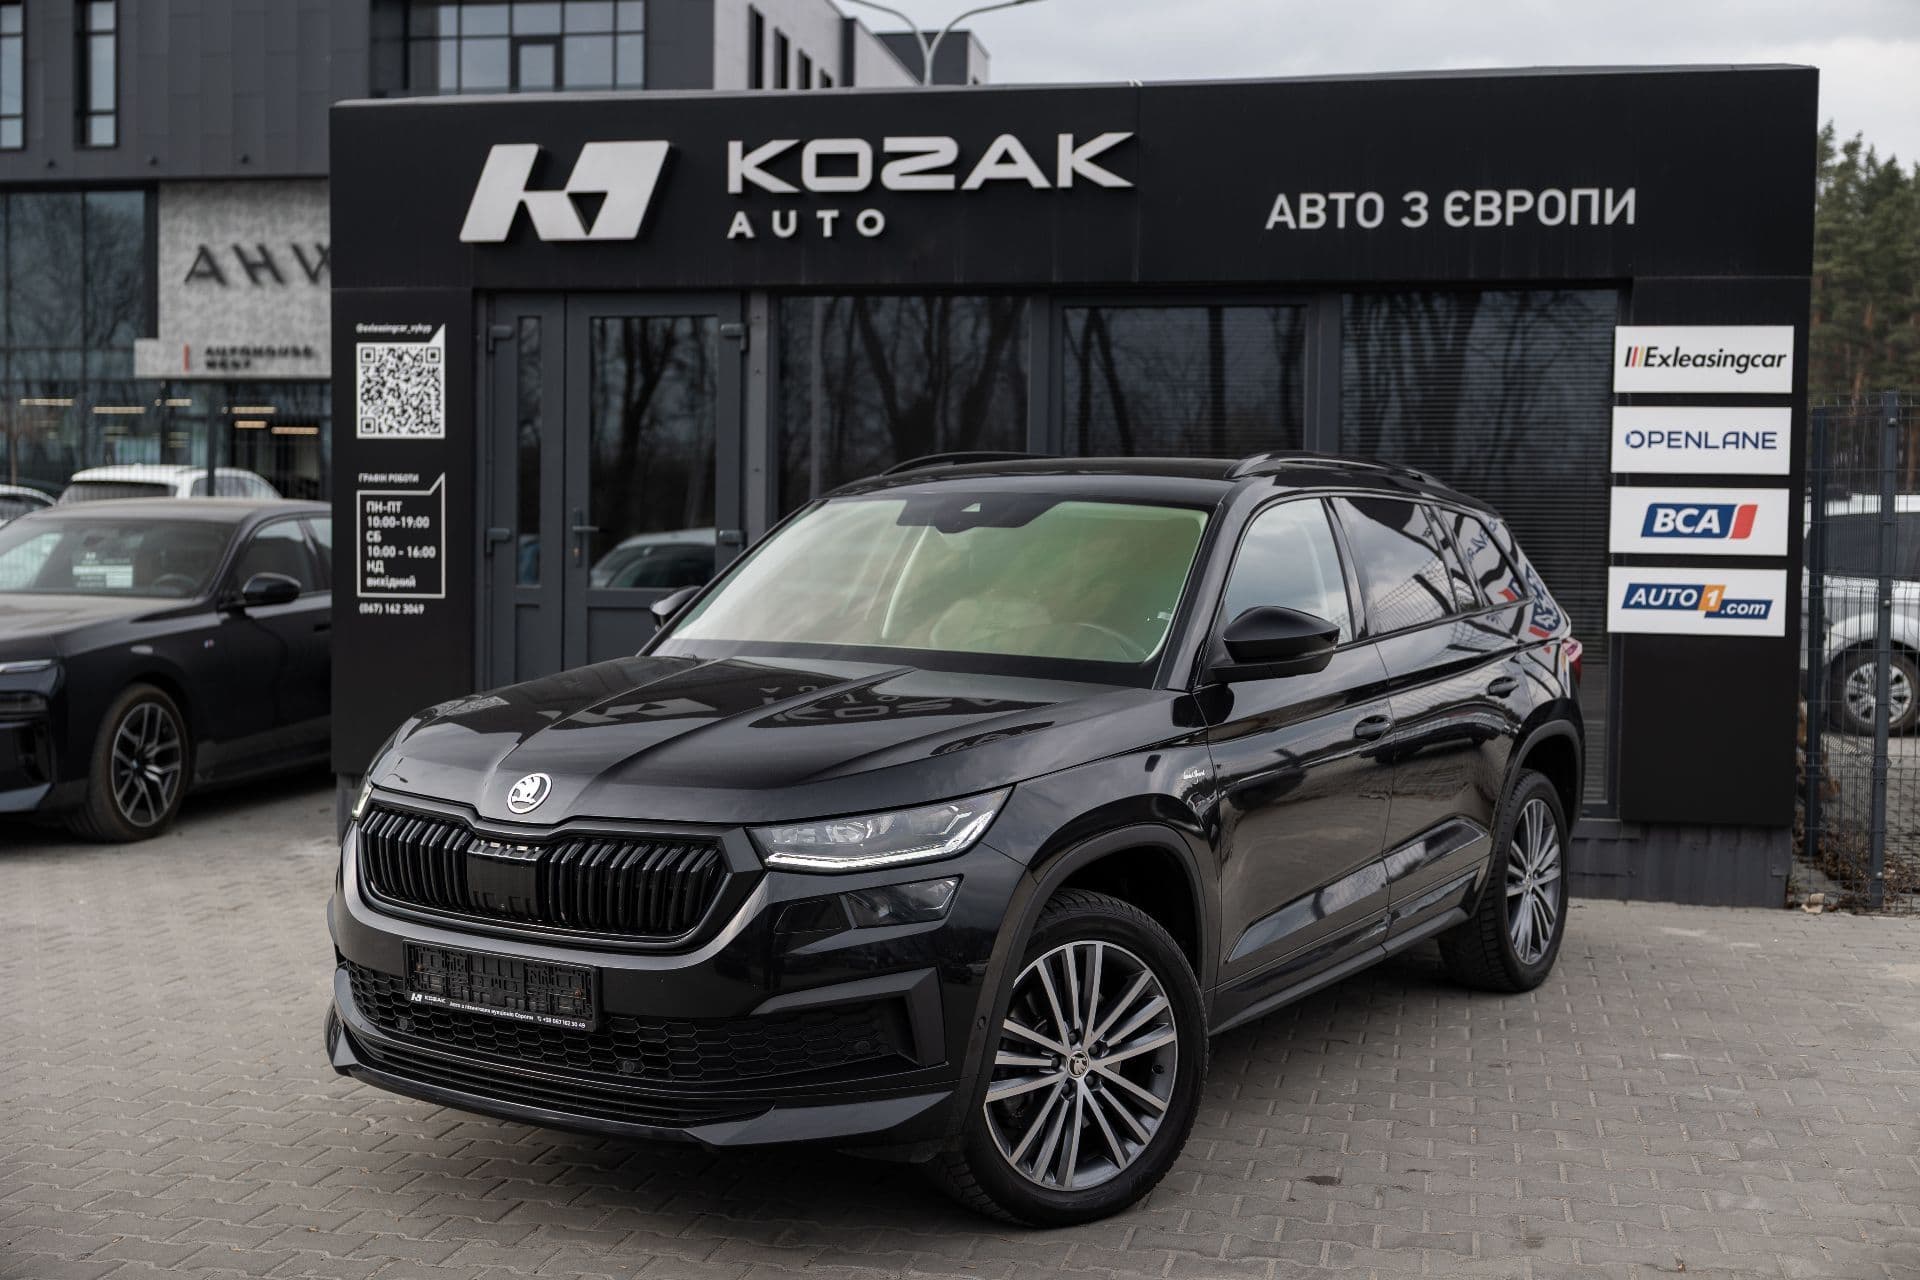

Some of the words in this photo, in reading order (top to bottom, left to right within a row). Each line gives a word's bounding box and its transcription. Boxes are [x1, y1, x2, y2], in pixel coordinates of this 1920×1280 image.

[727, 132, 1134, 193] KOZAK
[1265, 191, 1384, 230] АВТО
[1400, 190, 1429, 228] З
[1443, 187, 1636, 227] ЄВРОПИ
[727, 209, 885, 239] AUTO
[1643, 345, 1787, 374] Exleasingcar
[1625, 429, 1778, 450] OPENLANE
[366, 501, 402, 514] ПН-ПТ
[367, 516, 430, 528] 10:00-19:00
[1652, 507, 1721, 534] BCA
[366, 530, 382, 543] СБ
[407, 546, 436, 558] 16:00
[366, 560, 384, 574] НД
